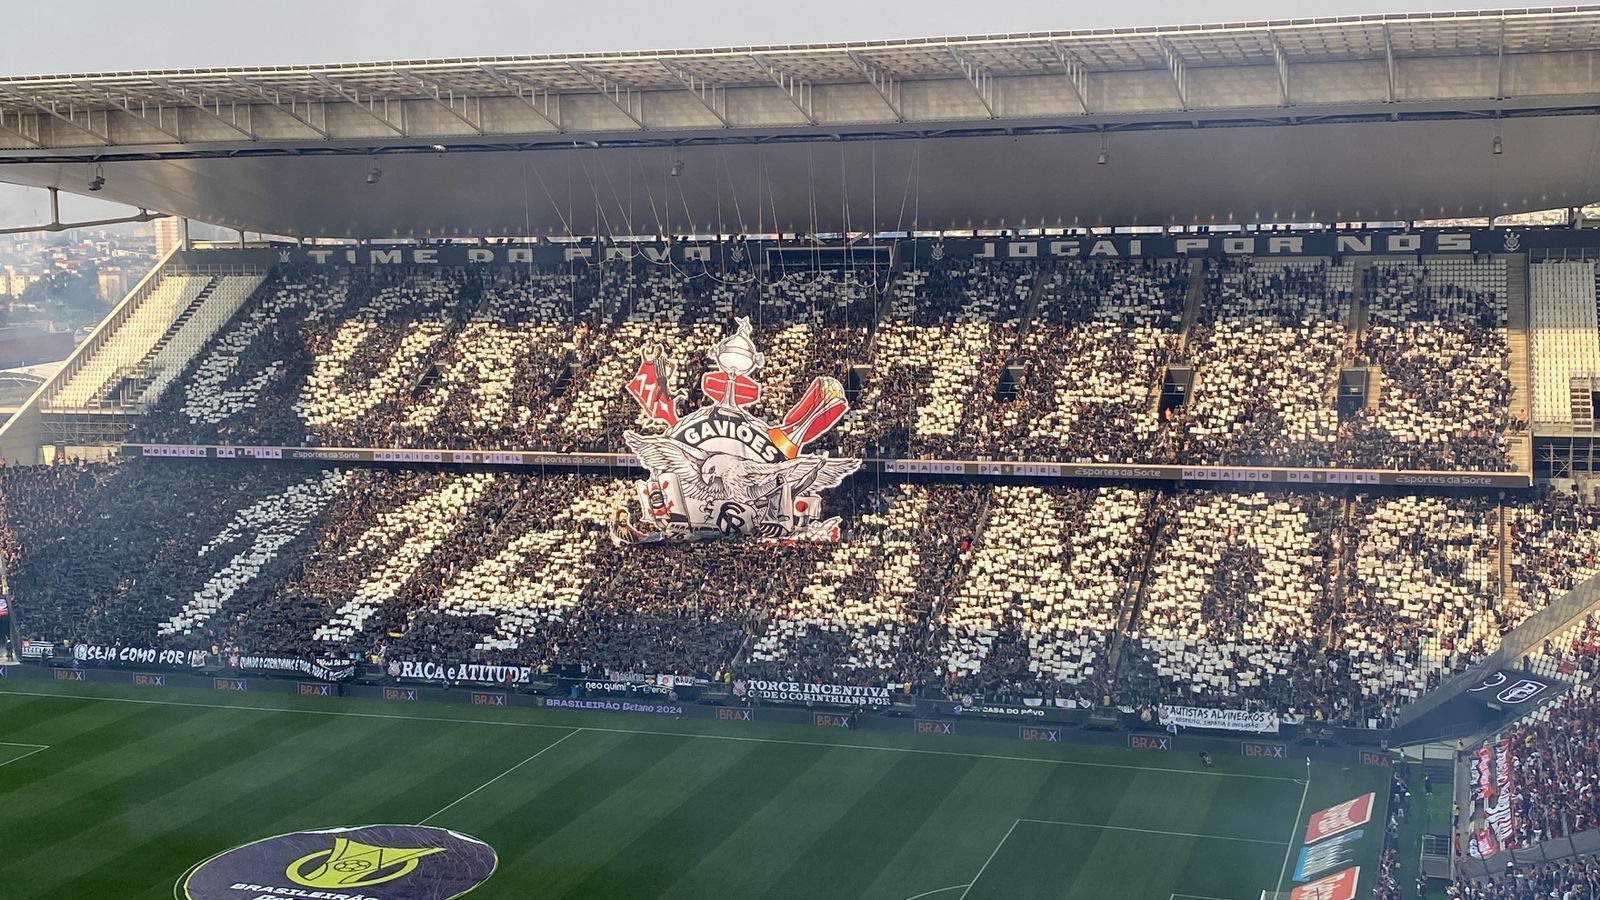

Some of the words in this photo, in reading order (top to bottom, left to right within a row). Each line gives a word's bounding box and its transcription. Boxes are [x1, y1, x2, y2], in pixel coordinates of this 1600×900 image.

[973, 240, 1141, 258] JOGAI
[1176, 237, 1303, 254] POR
[307, 249, 438, 264] TIME
[684, 420, 778, 462] GAVIÕES
[144, 448, 206, 457] MOSAICO
[886, 464, 963, 472] MOSAICO
[1184, 471, 1269, 479] MOSAICO
[87, 646, 116, 661] SEJA
[120, 647, 156, 664] COMO
[159, 650, 184, 664] FOR
[57, 670, 82, 681] BRAX
[400, 661, 446, 679] RAÇA
[447, 666, 456, 680] e
[457, 664, 530, 683] ATITUDE
[136, 675, 162, 686] BRAX
[217, 680, 243, 691] BRAX
[586, 682, 602, 690] neo
[300, 685, 327, 696] BRAX
[386, 690, 414, 701] BRAX
[803, 683, 890, 697] INCENTIVA
[474, 695, 503, 706] BRAX
[788, 693, 867, 705] CORINTHIANS
[868, 697, 892, 706] FOR
[546, 699, 620, 710] BRASILEIRÃO
[623, 702, 654, 713] Betano
[656, 705, 683, 714] 2024
[719, 709, 750, 721] BRAX
[1170, 706, 1209, 719] AUTISTAS
[1211, 710, 1264, 722] ALVINEGROS
[817, 715, 848, 727] BRAX
[918, 721, 950, 734] BRAX
[1023, 729, 1056, 742] BRAX
[1132, 737, 1167, 750] BRAX
[1246, 745, 1282, 758] BRAX
[1364, 753, 1390, 769] BRA
